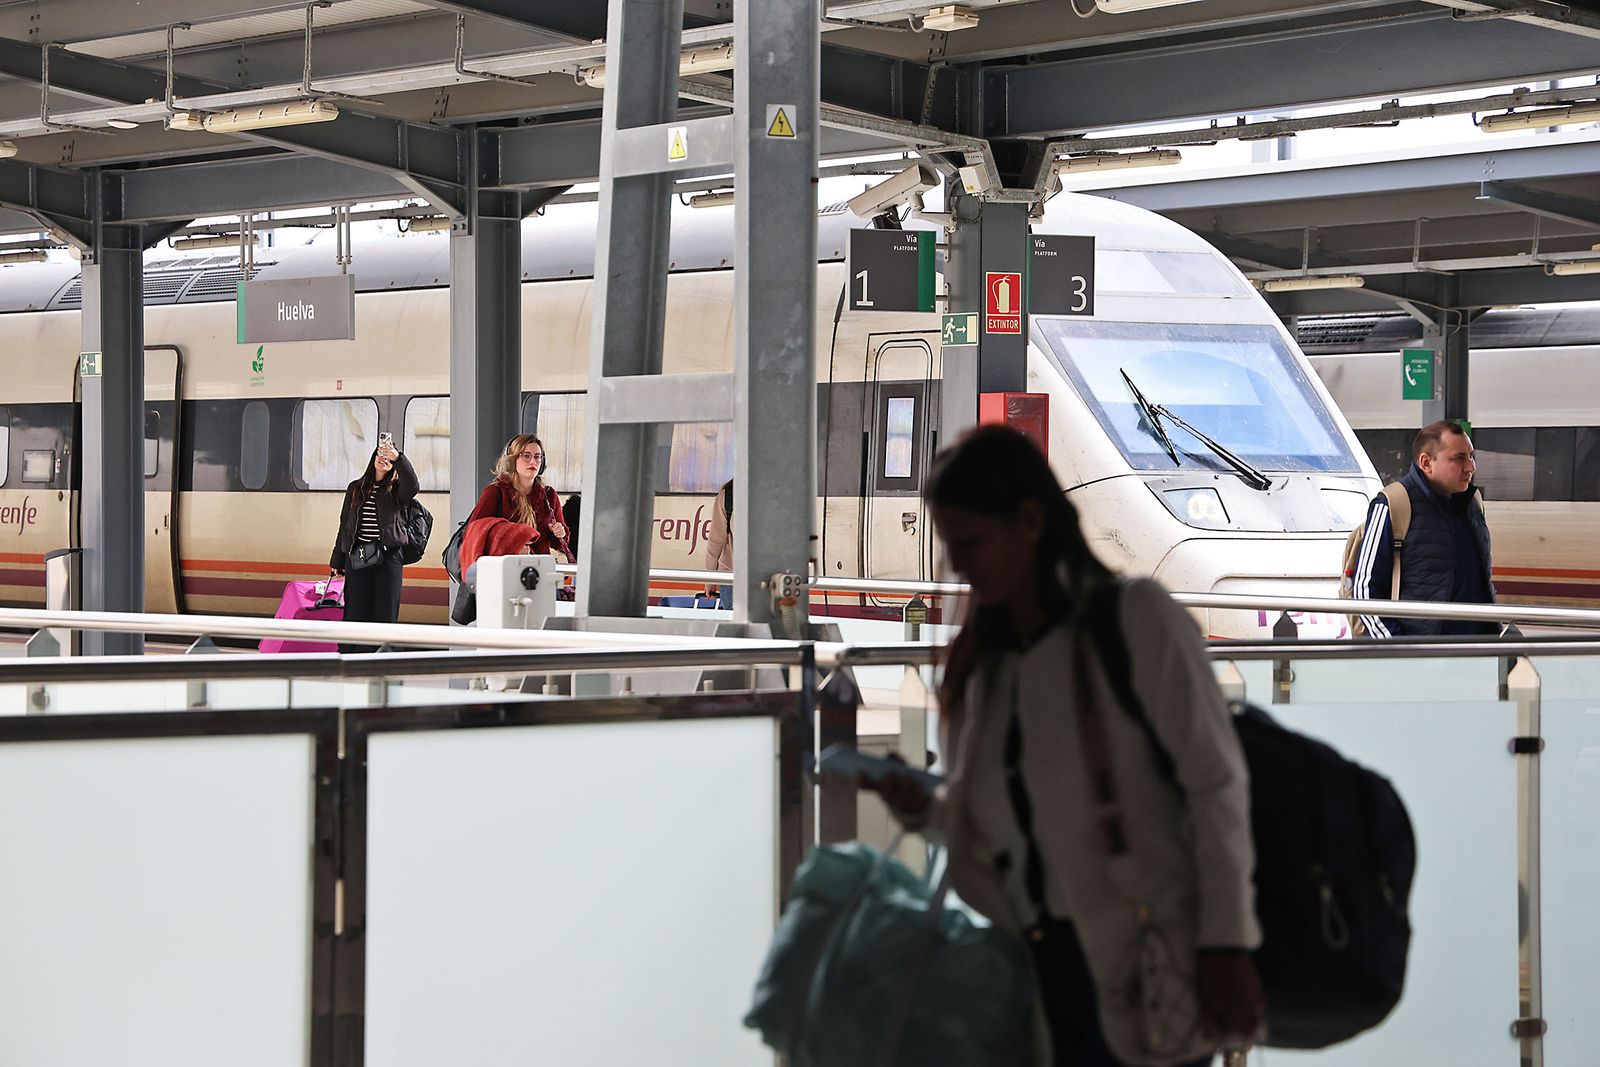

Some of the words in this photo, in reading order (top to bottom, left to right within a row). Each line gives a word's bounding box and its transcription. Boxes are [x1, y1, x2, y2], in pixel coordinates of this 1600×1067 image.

[906, 234, 918, 243] Vía
[1034, 239, 1046, 248] Vía
[855, 269, 874, 307] 1
[1070, 275, 1087, 312] 3
[277, 299, 315, 321] Huelva
[988, 318, 1019, 330] EXTINTOR
[0, 495, 37, 536] enfe
